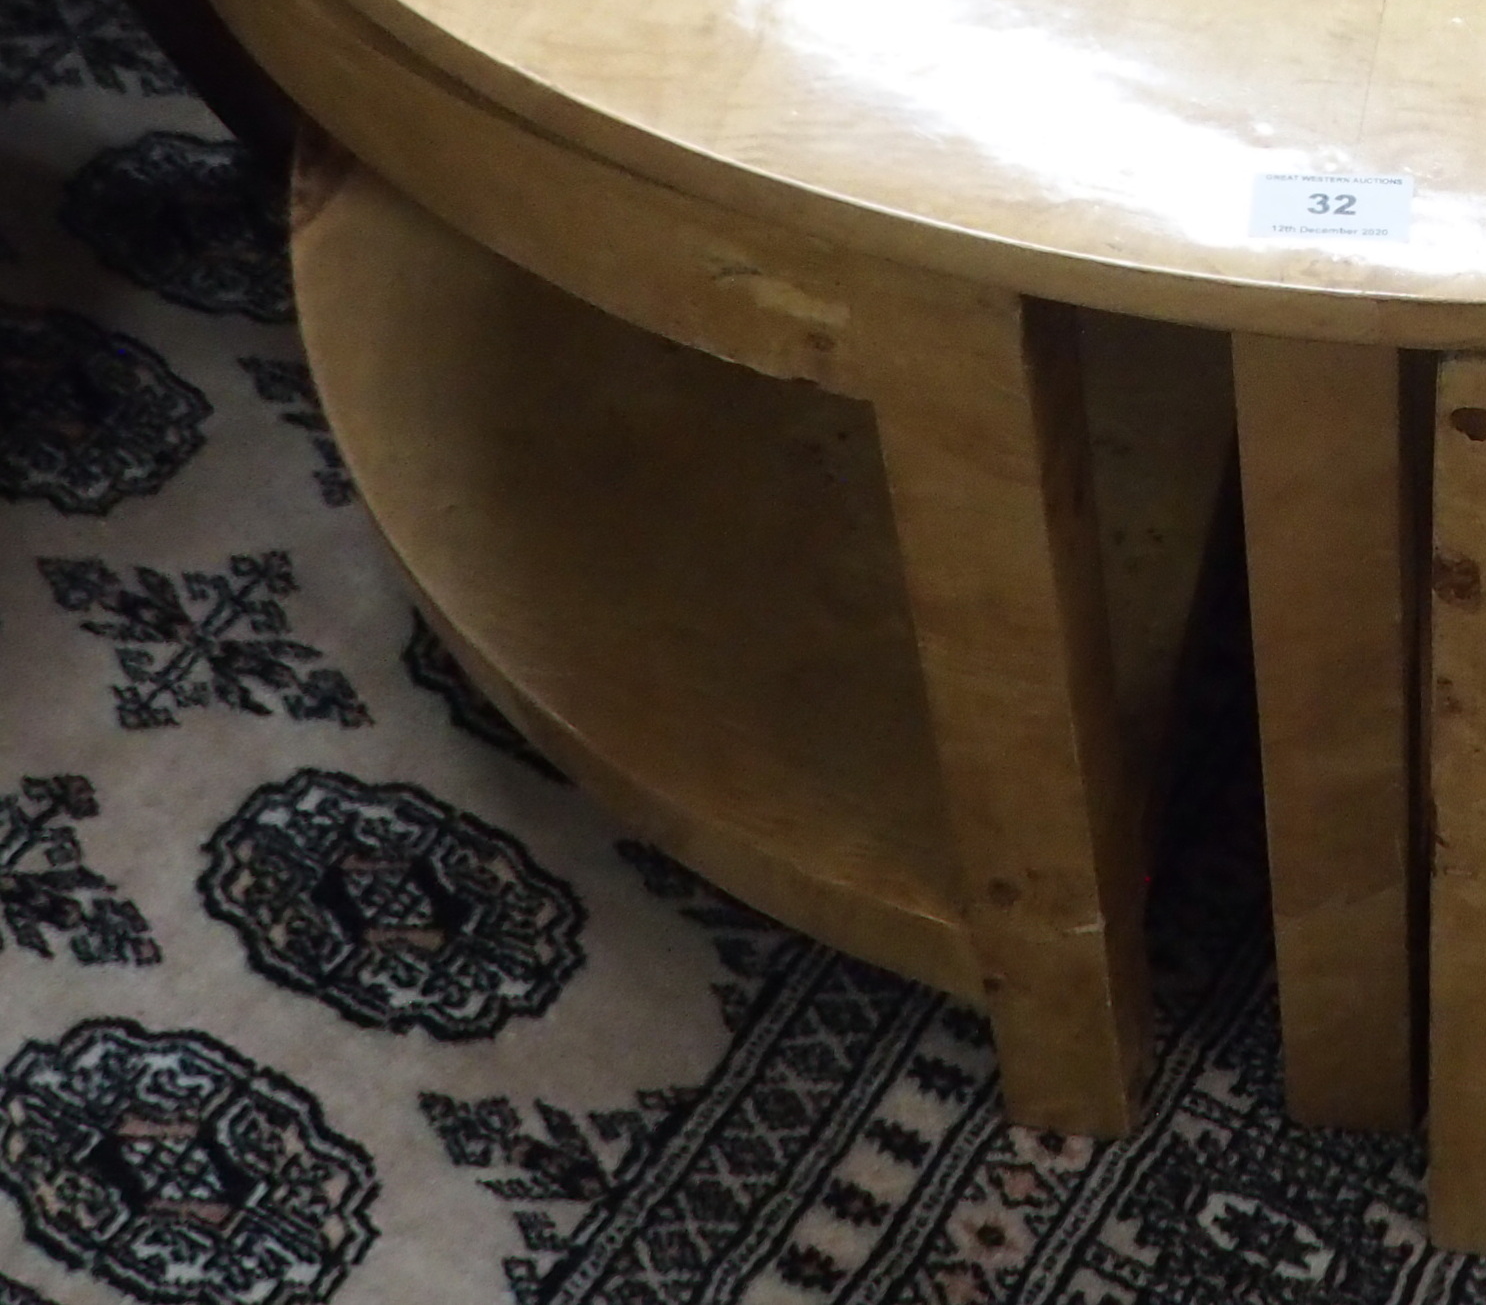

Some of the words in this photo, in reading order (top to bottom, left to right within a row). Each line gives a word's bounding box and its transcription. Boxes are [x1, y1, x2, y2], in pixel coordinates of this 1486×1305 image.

[1302, 175, 1350, 183] WESTERN
[1353, 177, 1403, 185] AUCTIONS
[1307, 193, 1357, 215] 32
[1272, 225, 1296, 233] 12th
[1300, 225, 1358, 235] December
[1362, 228, 1389, 236] 2020
